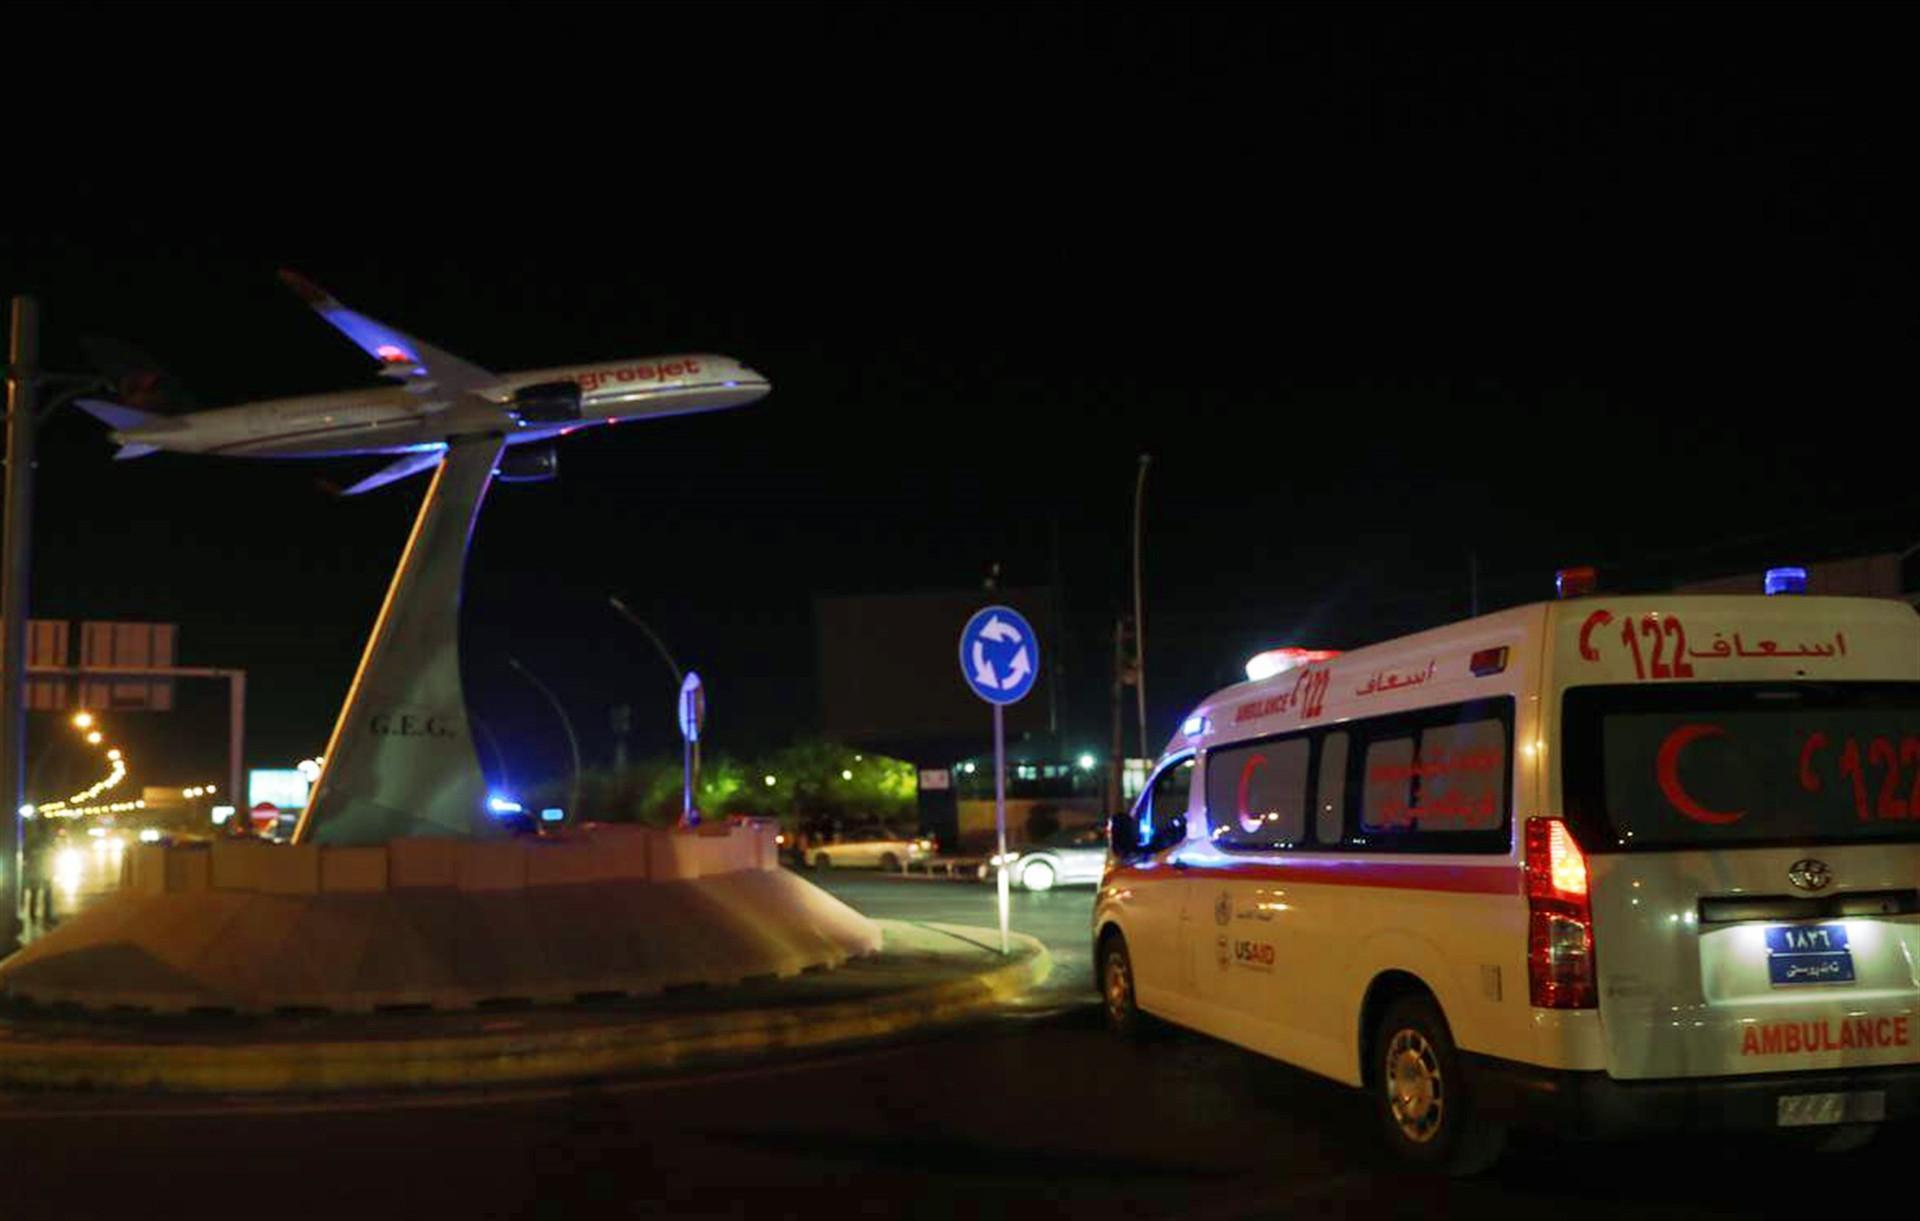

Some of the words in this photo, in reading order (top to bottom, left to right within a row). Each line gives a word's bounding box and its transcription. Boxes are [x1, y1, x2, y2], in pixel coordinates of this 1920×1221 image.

[1622, 615, 1694, 680] 122
[1688, 632, 1847, 658] اسعاف
[1235, 692, 1291, 723] AMBULANCE
[1234, 939, 1276, 965] USAID
[1740, 1016, 1910, 1056] AMBULANCE
